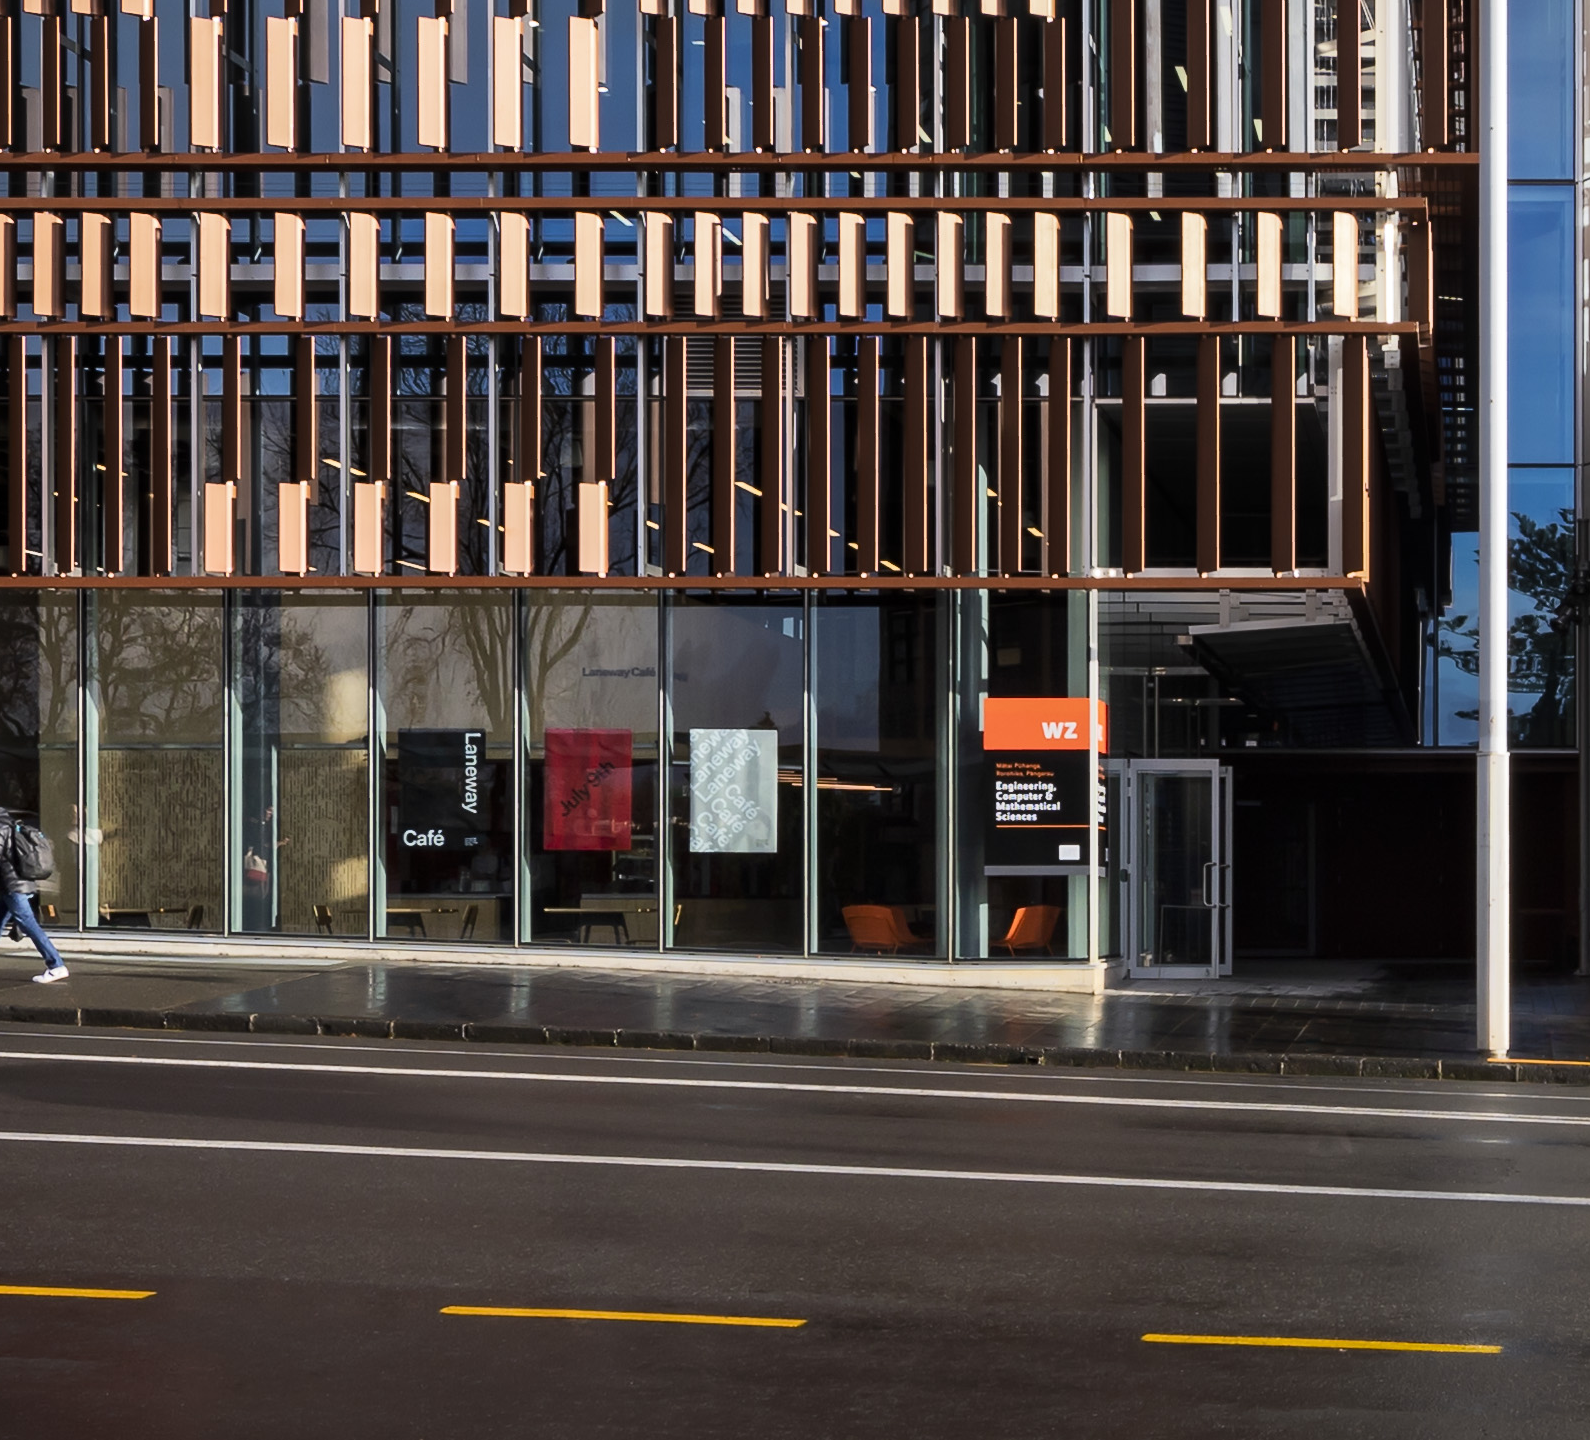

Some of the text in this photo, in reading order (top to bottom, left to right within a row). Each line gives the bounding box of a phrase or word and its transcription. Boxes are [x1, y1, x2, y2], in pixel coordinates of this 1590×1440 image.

[582, 666, 656, 678] Laneway Café
[1042, 722, 1078, 739] WZ
[461, 732, 482, 814] Laneway
[694, 740, 761, 803] Laneway
[561, 760, 616, 817] July 9th
[996, 781, 1057, 792] Engineering,
[725, 784, 761, 820] Café
[996, 792, 1043, 802] Computer
[996, 802, 1061, 811] Mathematical
[711, 798, 747, 833] Café
[996, 812, 1037, 821] Sciences
[403, 829, 445, 846] Café
[697, 811, 733, 847] Café
